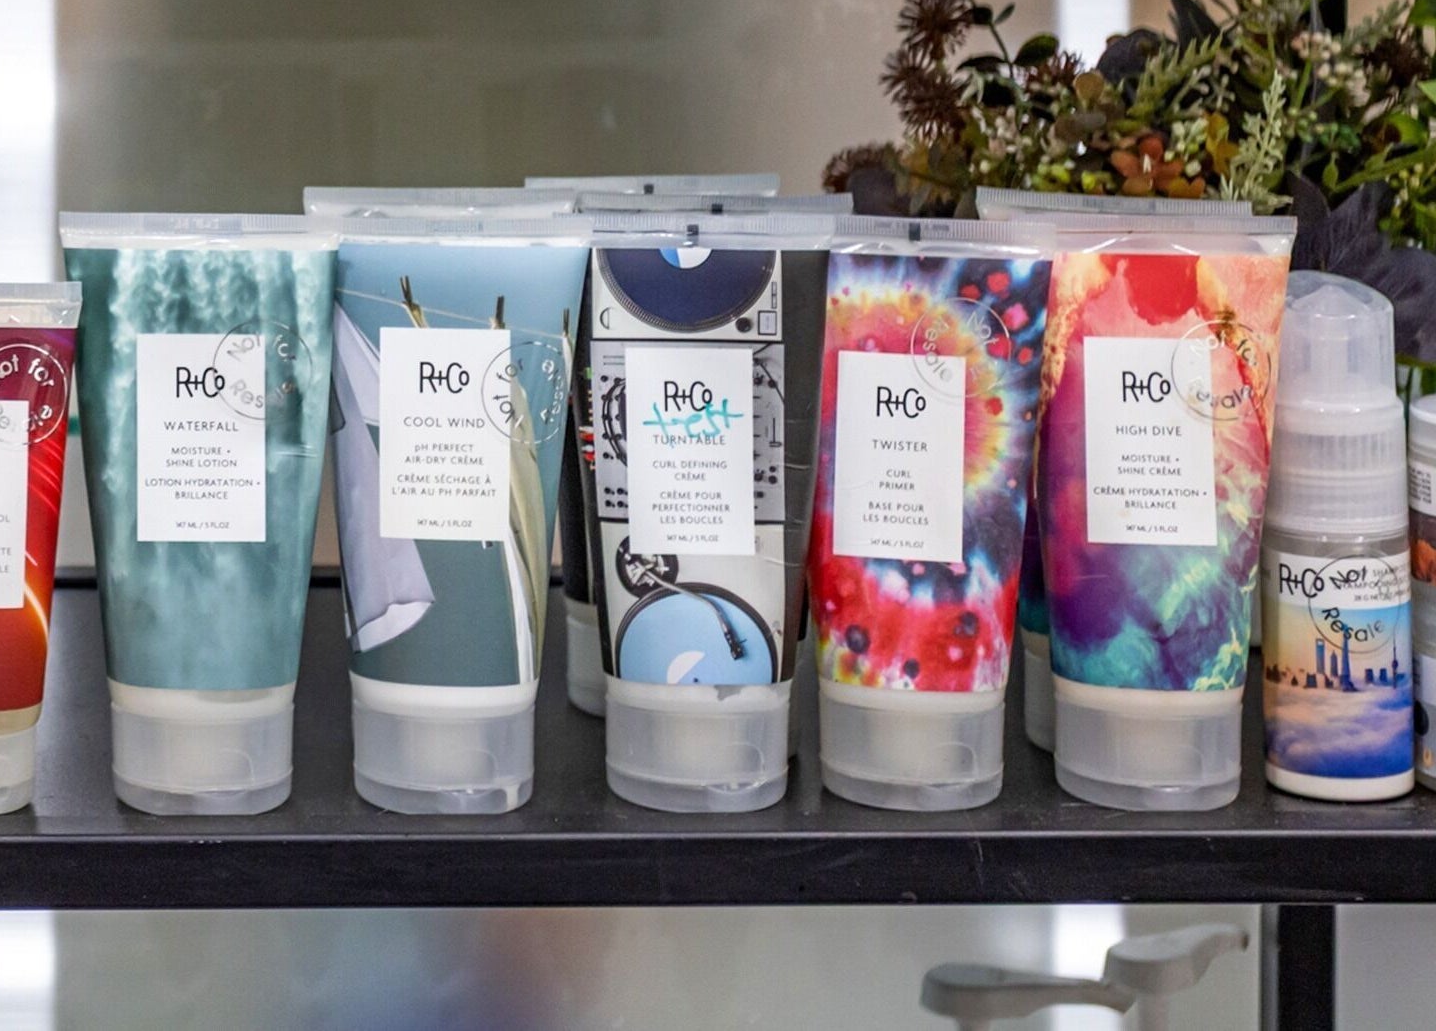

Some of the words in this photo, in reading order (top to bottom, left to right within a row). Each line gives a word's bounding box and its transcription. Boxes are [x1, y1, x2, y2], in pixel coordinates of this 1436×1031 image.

[28, 358, 55, 388] for
[419, 361, 470, 394] R+Co
[176, 367, 225, 398] R+Co
[1123, 371, 1171, 403] R+Co
[664, 381, 713, 412] R+Co
[876, 386, 926, 418] R+Co
[164, 421, 239, 431] WATERFALL
[403, 416, 442, 428] COOL
[448, 417, 484, 429] WIND
[1116, 425, 1147, 436] HIGH
[1152, 426, 1182, 436] DIVE
[653, 435, 726, 445] TURNTABLE
[873, 440, 928, 452] TWISTER
[166, 459, 194, 467] SHINE
[198, 459, 237, 467] LOTION
[886, 469, 911, 478] CURL
[879, 482, 915, 490] PRIMER
[1125, 500, 1176, 509] BRILLANCE
[1279, 563, 1325, 598] R+Co
[1322, 606, 1384, 642] Resale
